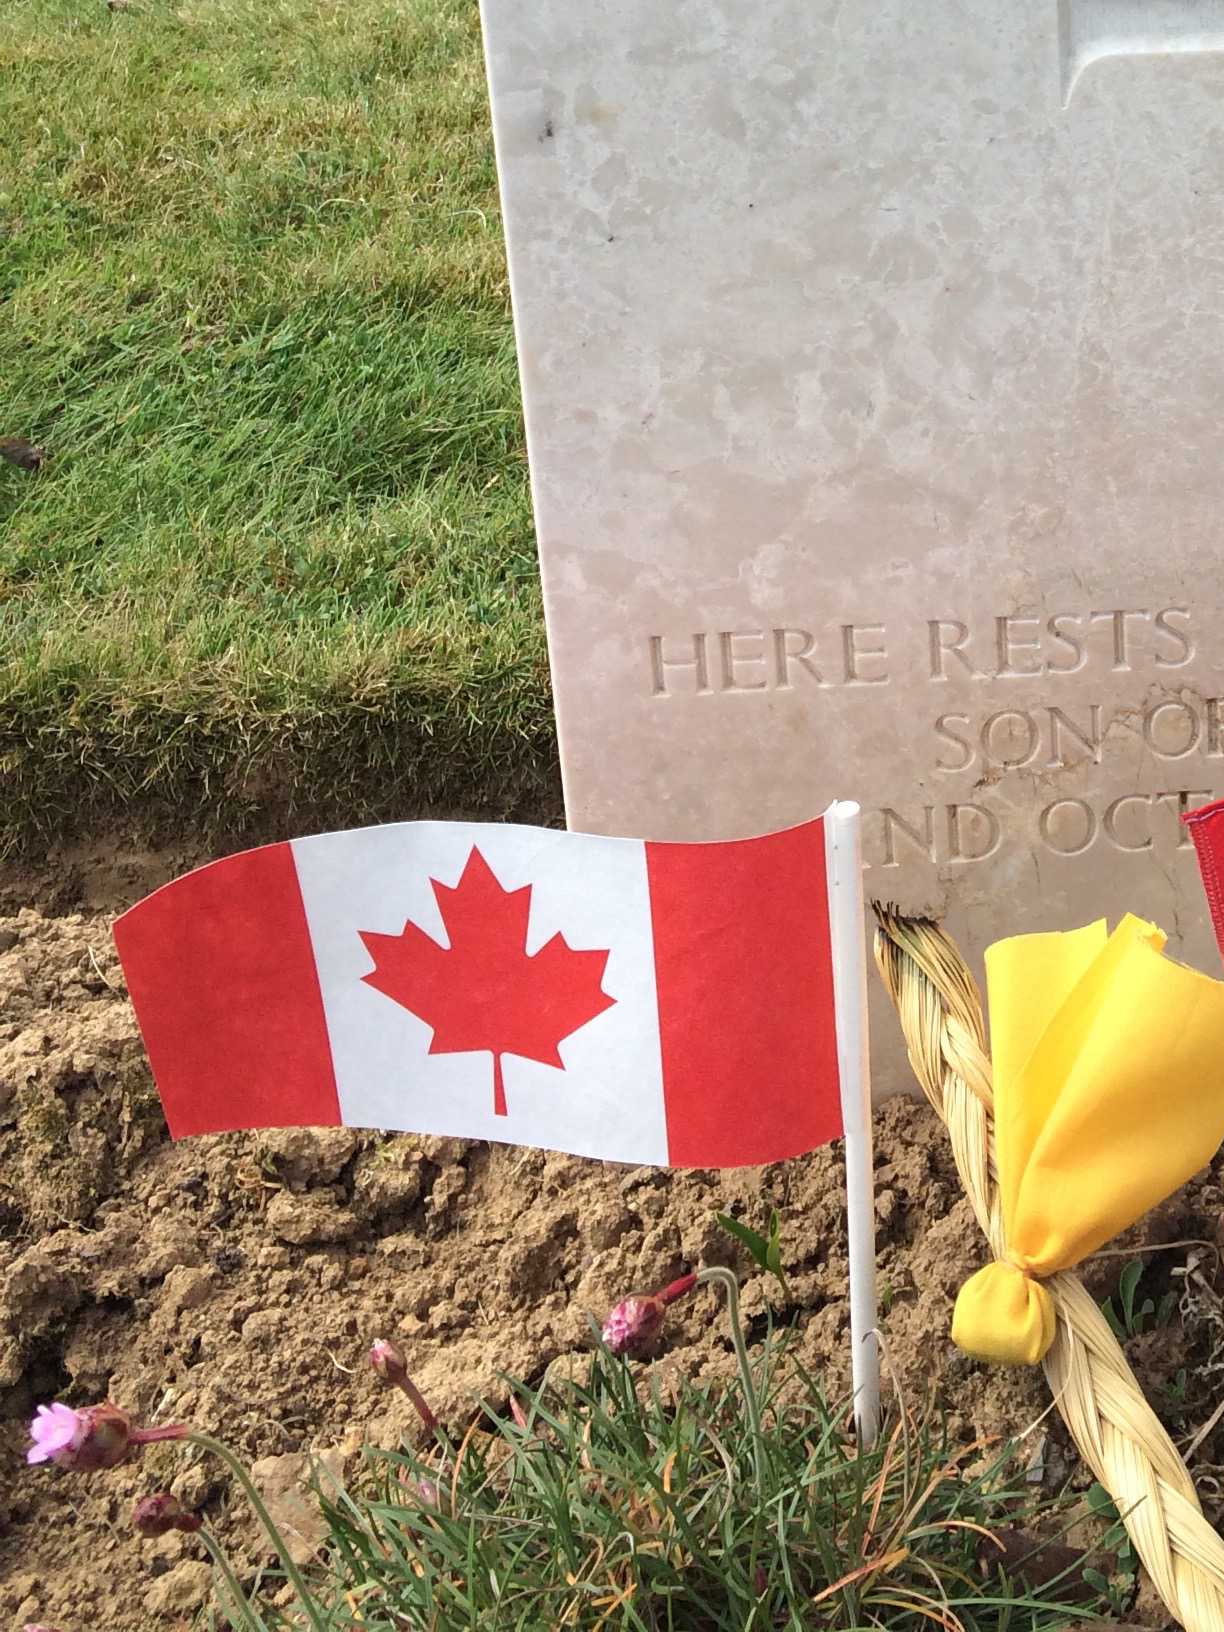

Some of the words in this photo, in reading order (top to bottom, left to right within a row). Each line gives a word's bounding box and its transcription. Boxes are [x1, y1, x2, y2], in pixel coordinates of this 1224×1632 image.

[648, 622, 891, 698] HERE
[927, 606, 1197, 683] RESTS
[934, 705, 1102, 773] SON
[862, 802, 1000, 869] ND
